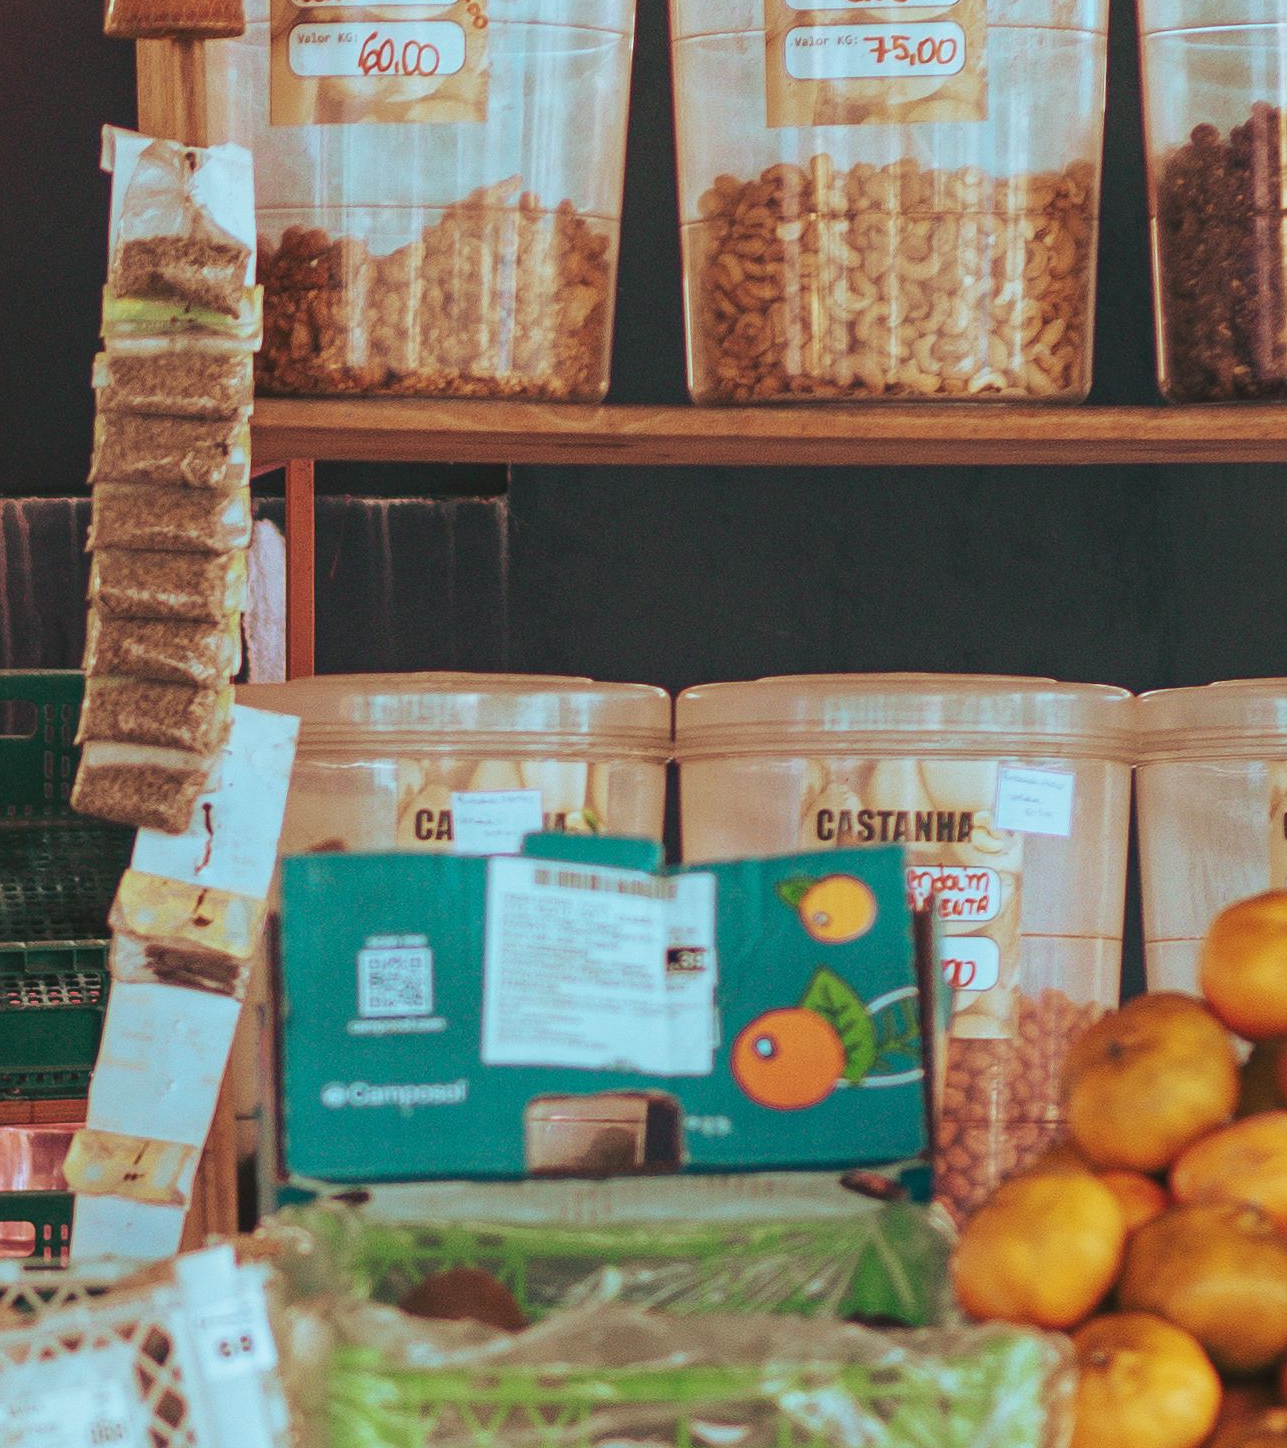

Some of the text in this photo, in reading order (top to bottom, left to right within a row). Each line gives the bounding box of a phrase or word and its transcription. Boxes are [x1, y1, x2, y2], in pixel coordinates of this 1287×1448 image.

[297, 32, 329, 44] Valor
[794, 37, 830, 48] Valor
[862, 35, 959, 67] 75,00
[816, 808, 974, 843] CASTANHA
